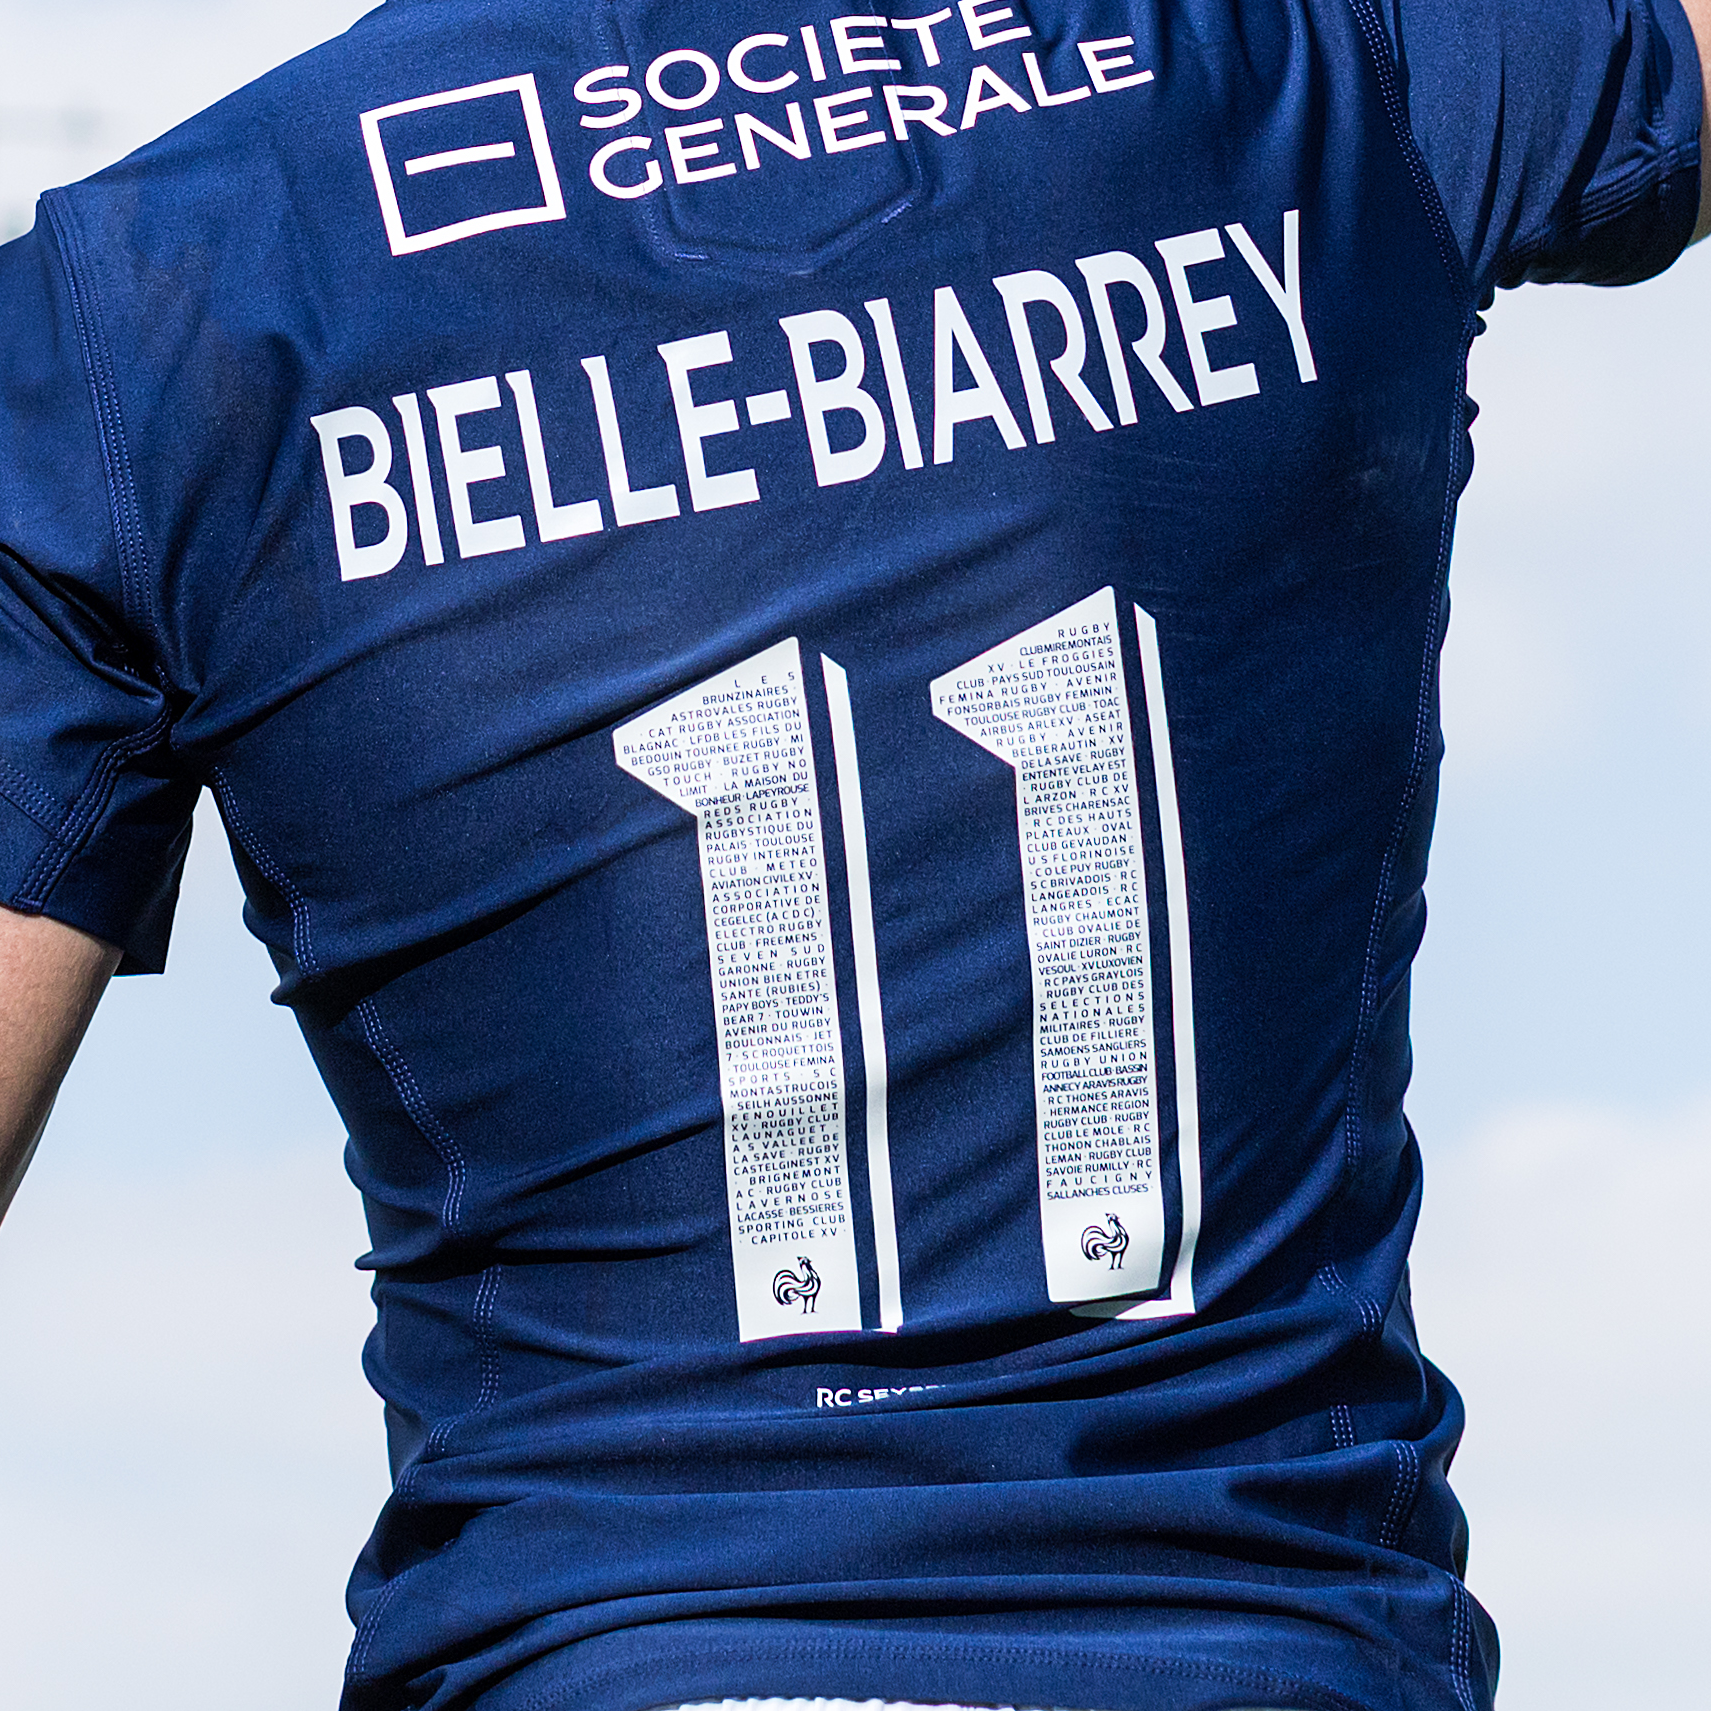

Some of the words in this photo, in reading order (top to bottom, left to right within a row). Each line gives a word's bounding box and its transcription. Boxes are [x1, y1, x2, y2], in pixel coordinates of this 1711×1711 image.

[587, 35, 1156, 200] GENERALE
[309, 208, 1319, 583] BIELLE-BIARREY
[1057, 622, 1110, 638] RUGBY
[956, 678, 985, 690] CLUB
[991, 673, 1020, 686] PAYS
[1021, 670, 1044, 681] SUD
[1046, 659, 1115, 677] TOULOUSAIN
[702, 685, 789, 705] BRUNZINAIRES
[939, 689, 994, 705] FEMINA
[1001, 682, 1047, 697] RUGBY
[1066, 672, 1117, 688] AVENIR
[671, 702, 753, 722] ASTROVALES
[757, 696, 797, 710] RUGBY
[947, 698, 1021, 716] FONSORBAIS
[1023, 693, 1061, 706] RUGBY
[1065, 685, 1112, 700] FEMININ
[964, 711, 1020, 726] TOULOUSE
[1022, 706, 1056, 718] RUGBY
[1059, 702, 1086, 714] CLUB
[1093, 696, 1120, 709] TOAC
[648, 726, 672, 738] CAT
[679, 719, 722, 734] RUGBY
[727, 709, 800, 727] ASSOCIATION
[996, 732, 1046, 747] RUGBY
[1067, 721, 1123, 738] AVENIR
[623, 738, 678, 755] BLAGNAC
[689, 733, 720, 745] LFDB
[724, 728, 747, 740] LES
[752, 724, 780, 736] FILS
[785, 721, 802, 732] DU
[1012, 738, 1097, 758] BELBERAUTIN
[1108, 734, 1124, 745] XV
[631, 751, 682, 766] BEDOUIN
[685, 742, 739, 758] TOURNEE
[743, 737, 780, 750] RUGBY
[790, 733, 804, 744] MI
[647, 765, 670, 776] GSO
[673, 759, 711, 773] RUGBY
[723, 752, 759, 766] BUZET
[763, 746, 804, 760] RUGBY
[1022, 766, 1070, 782] ENTENTE
[1071, 762, 1105, 775] VELAY
[1107, 758, 1126, 770] EST
[663, 772, 711, 787] TOUCH
[731, 762, 779, 777] RUGBY
[788, 758, 807, 769] NO
[1030, 778, 1072, 792] RUGBY
[1077, 774, 1109, 787] CLUB
[1113, 771, 1128, 782] DE
[679, 785, 707, 797] LIMIT
[724, 781, 739, 791] LA
[744, 774, 787, 788] MAISON
[792, 771, 808, 782] DU
[1024, 803, 1063, 817] BRIVES
[1065, 795, 1131, 812] CHARENSAC
[705, 808, 812, 830] ASSOCIATION
[705, 822, 792, 841] RUGBYSTIQUE
[796, 820, 813, 831] DU
[1025, 826, 1090, 841] PLATEAUX
[1101, 820, 1133, 833] OVAL
[706, 840, 747, 853] PALAIS
[755, 832, 815, 848] TOULOUSE
[1027, 841, 1057, 853] CLUB
[1061, 833, 1127, 850] GEVAUDAN
[708, 853, 748, 865] RUGBY
[753, 845, 815, 860] INTERNAT
[709, 866, 747, 879] CLUB
[766, 857, 817, 872] METEO
[711, 876, 761, 891] AVIATION
[762, 872, 796, 885] CIVILE
[797, 870, 813, 881] XV
[712, 882, 820, 903] ASSOCIATION
[712, 897, 800, 915] CORPORATIVE
[805, 894, 821, 905] DE
[714, 913, 762, 927] CEGELEC
[1033, 914, 1071, 926] RUGBY
[1075, 906, 1139, 922] CHAUMONT
[715, 924, 774, 940] ELECTRO
[779, 919, 822, 932] RUGBY
[1042, 926, 1074, 938] CLUB
[1078, 921, 1121, 934] OVALIE
[1126, 918, 1141, 929] DE
[716, 940, 746, 953] CLUB
[755, 931, 817, 948] FREEMENS
[1036, 939, 1066, 952] SAINT
[1069, 936, 1101, 948] DIZIER
[1107, 931, 1141, 944] RUGBY
[613, 585, 1196, 1343] 11
[718, 961, 775, 977] GARONNE
[786, 955, 825, 969] RUGBY
[719, 976, 759, 989] UNION
[763, 972, 792, 984] BIEN
[796, 968, 827, 981] ETRE
[1046, 986, 1085, 999] RUGBY
[1088, 982, 1118, 994] CLUB
[1122, 979, 1144, 991] DES
[721, 988, 761, 1001] SANTE
[1039, 991, 1145, 1012] SELECTIONS
[722, 1002, 749, 1014] PAPY
[751, 998, 779, 1011] BOYS
[1039, 1003, 1145, 1023] NATIONALES
[724, 1024, 768, 1038] AVENIR
[771, 1022, 788, 1032] DU
[791, 1017, 831, 1030] RUGBY
[1039, 1019, 1101, 1034] MILITAIRES
[1108, 1015, 1145, 1027] RUGBY
[725, 1033, 802, 1050] BOULONNAIS
[814, 1030, 832, 1040] JET
[1039, 1034, 1069, 1046] CLUB
[1072, 1032, 1087, 1043] DE
[1090, 1027, 1139, 1041] FILLIERE
[1040, 1044, 1091, 1058] SAMOENS
[1091, 1038, 1147, 1053] SANGLIERS
[1040, 1056, 1091, 1070] RUGBY
[1099, 1051, 1147, 1065] UNION
[730, 1079, 838, 1098] MONTASTRUCOIS
[737, 1099, 771, 1111] SEILH
[774, 1091, 838, 1107] AUSSONNE
[1050, 1102, 1109, 1117] HERMANCE
[1110, 1098, 1150, 1111] REGION
[731, 1101, 838, 1123] FENOUILLET
[731, 1122, 748, 1132] XV
[761, 1116, 803, 1130] RUGBY
[807, 1112, 839, 1124] CLUB
[1043, 1117, 1078, 1130] RUGBY
[1080, 1114, 1108, 1126] CLUB
[1114, 1110, 1150, 1123] RUGBY
[731, 1123, 826, 1142] LAUNAGUET
[733, 1154, 749, 1165] LA
[753, 1149, 785, 1162] SAVE
[798, 1143, 839, 1157] RUGBY
[1044, 1140, 1092, 1153] THONON
[1094, 1134, 1151, 1149] CHABLAIS
[733, 1156, 820, 1176] CASTELGINEST
[824, 1153, 840, 1164] XV
[1045, 1152, 1082, 1165] LEMAN
[1088, 1149, 1123, 1161] RUGBY
[1125, 1146, 1152, 1158] CLUB
[749, 1165, 841, 1186] BRIGNEMONT
[1046, 1170, 1152, 1189] FAUCIGNY
[736, 1189, 842, 1211] LAVERNOSE
[738, 1218, 804, 1235] SPORTING
[812, 1214, 846, 1226] CLUB
[751, 1229, 815, 1245] CAPITOLE
[820, 1227, 837, 1237] XV
[816, 1387, 852, 1408] RC
